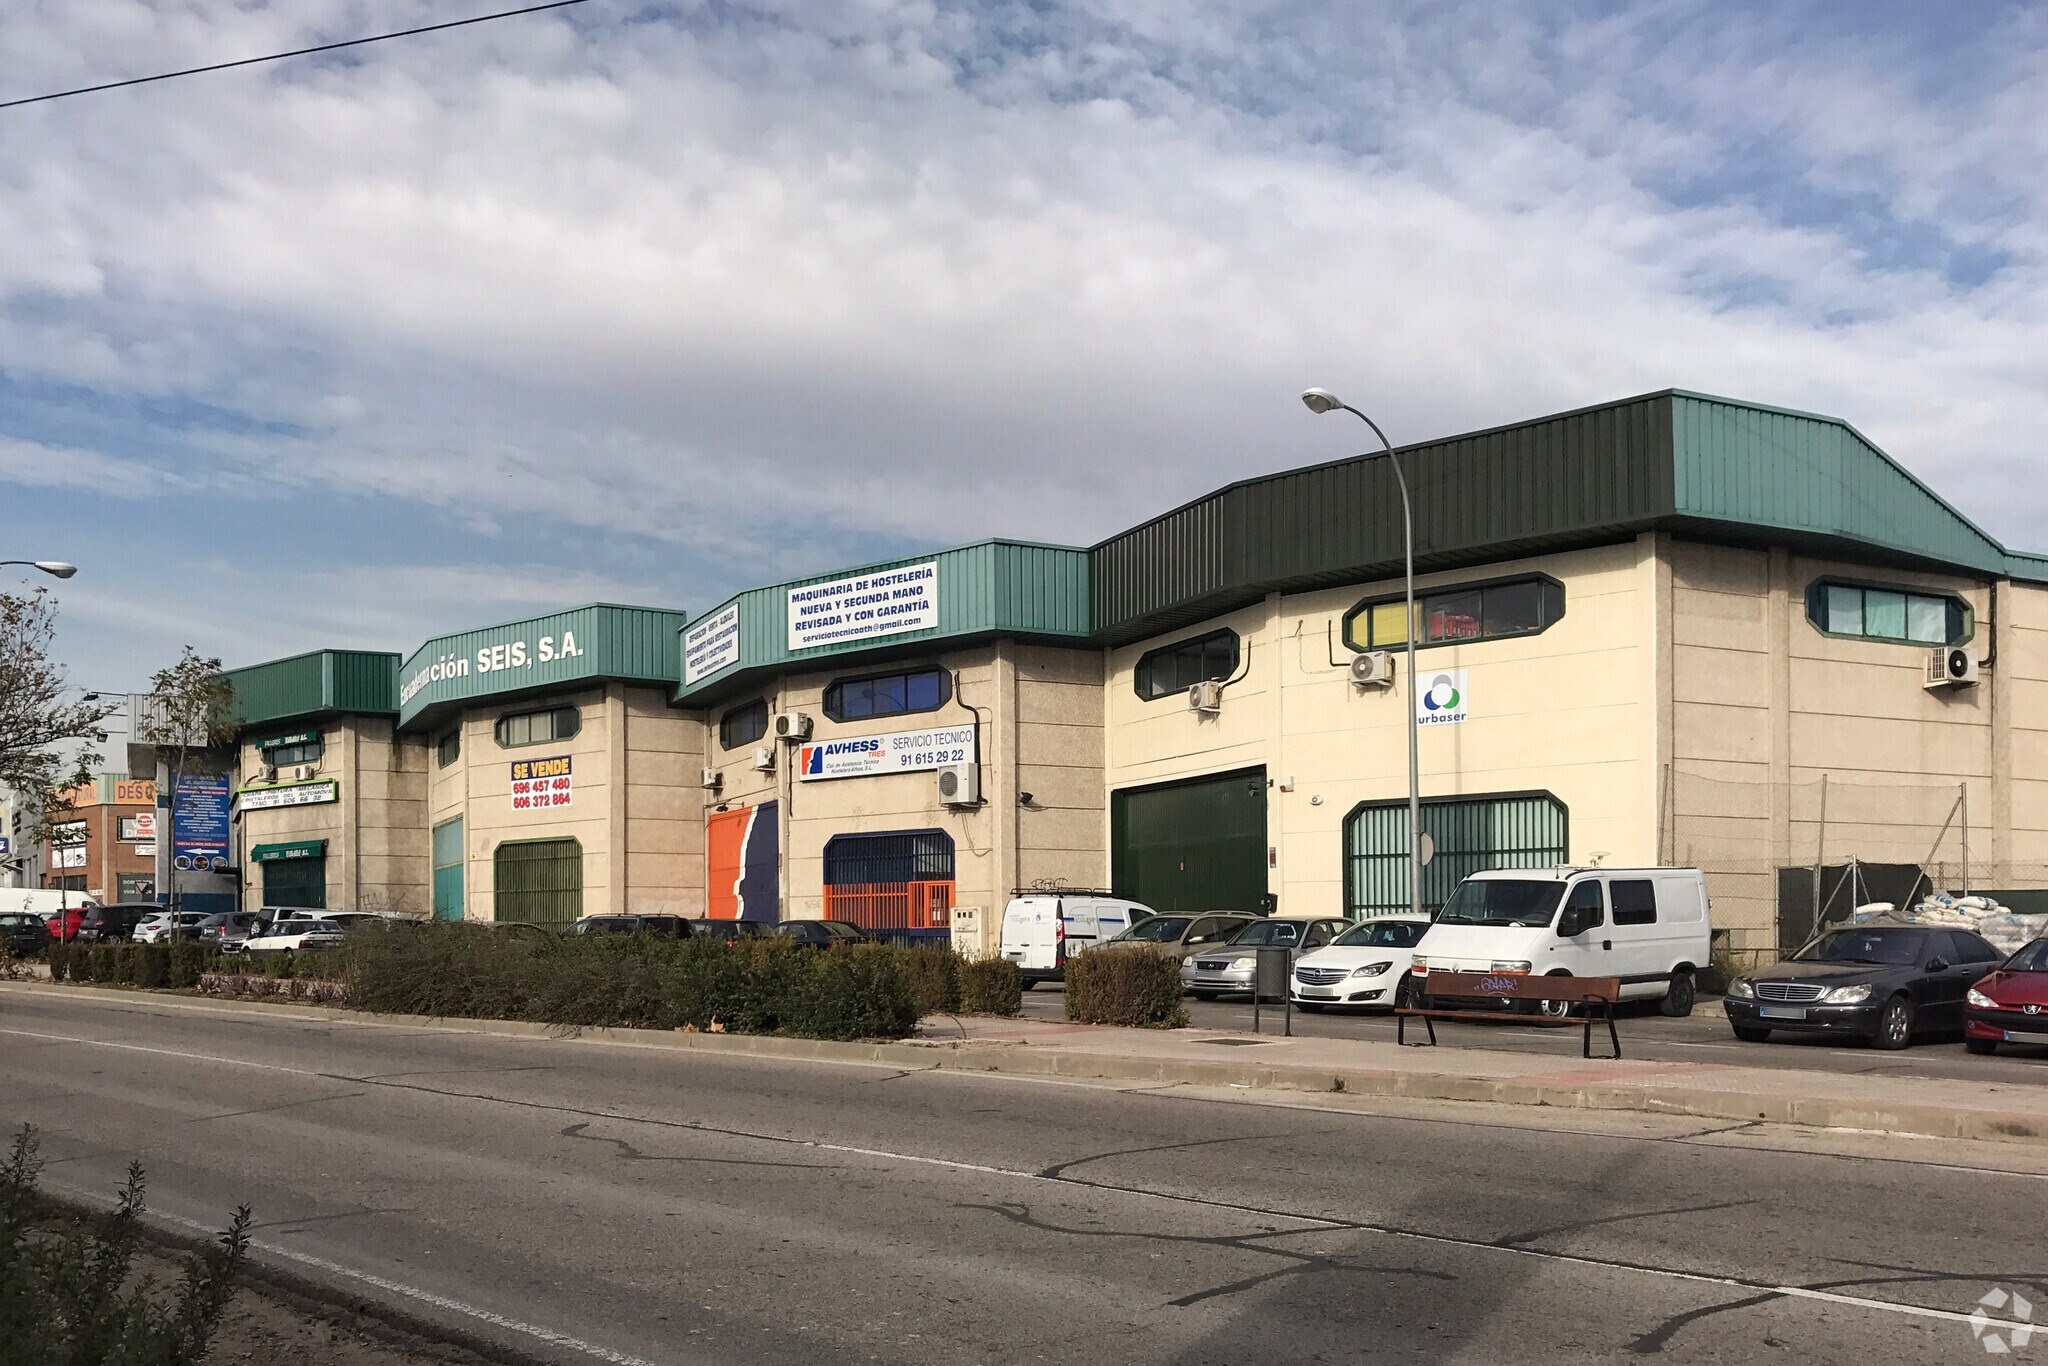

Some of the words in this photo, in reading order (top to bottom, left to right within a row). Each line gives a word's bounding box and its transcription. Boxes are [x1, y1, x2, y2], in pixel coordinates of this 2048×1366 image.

[791, 583, 853, 604] MAQUINARIA
[855, 580, 869, 591] DE
[871, 566, 933, 588] HOSTELERÍA
[800, 602, 832, 616] NUEVA
[835, 599, 842, 610] Y
[844, 591, 890, 609] SEGUNDA
[892, 585, 924, 600] MANO
[795, 614, 842, 632] REVISADA
[845, 613, 852, 623] Y
[854, 608, 874, 621] CON
[877, 598, 930, 618] GARANTÍA
[802, 616, 922, 643] serviciotecnicoath@gmail.com
[477, 641, 534, 671] SEIS,
[538, 631, 584, 663] S.A.
[1418, 712, 1467, 725] urbaser
[824, 739, 880, 756] AVHESS
[893, 734, 932, 751] SERVICIO
[934, 729, 973, 745] TECNICO
[868, 750, 886, 758] TRES
[901, 754, 913, 766] 91
[915, 752, 934, 765] 615
[936, 750, 949, 763] 29
[951, 749, 964, 762] 22
[513, 763, 529, 780] SE
[530, 758, 570, 778] VENDE
[513, 781, 531, 795] 696
[532, 779, 550, 792] 457
[552, 777, 571, 791] 480
[513, 796, 531, 809] 606
[532, 794, 550, 808] 372
[552, 791, 571, 806] 864
